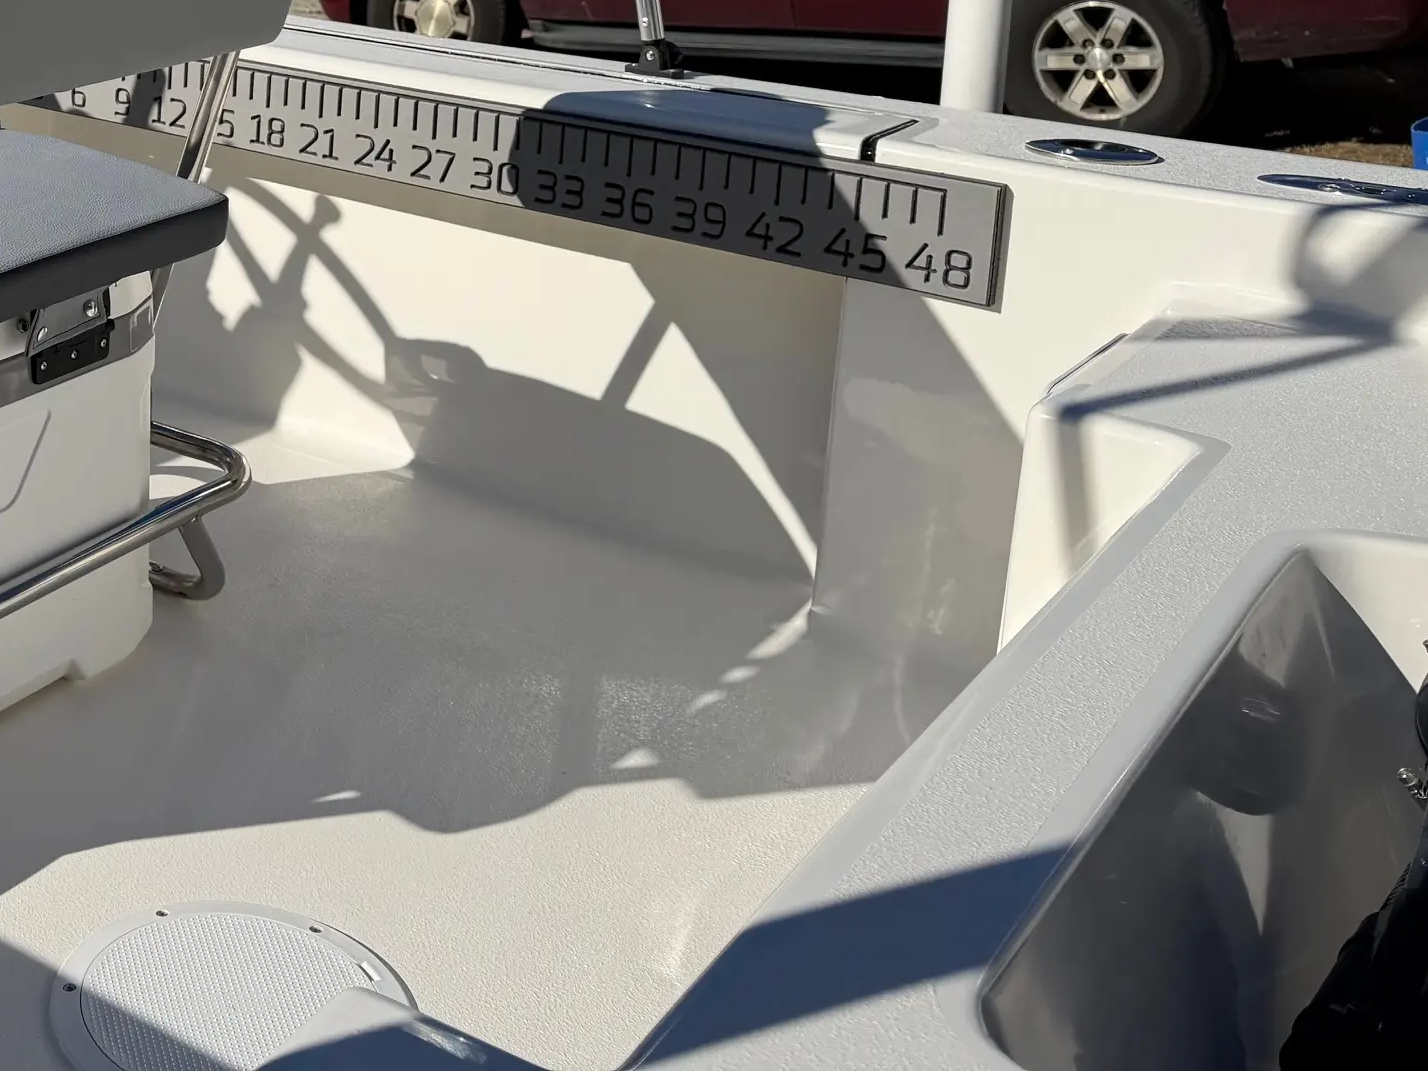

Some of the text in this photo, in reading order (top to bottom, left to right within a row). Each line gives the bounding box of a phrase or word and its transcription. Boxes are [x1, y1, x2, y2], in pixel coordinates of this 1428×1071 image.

[71, 86, 972, 290] 6 9 12 5 18 21 24 27 30 33 36 39 42 45 48
